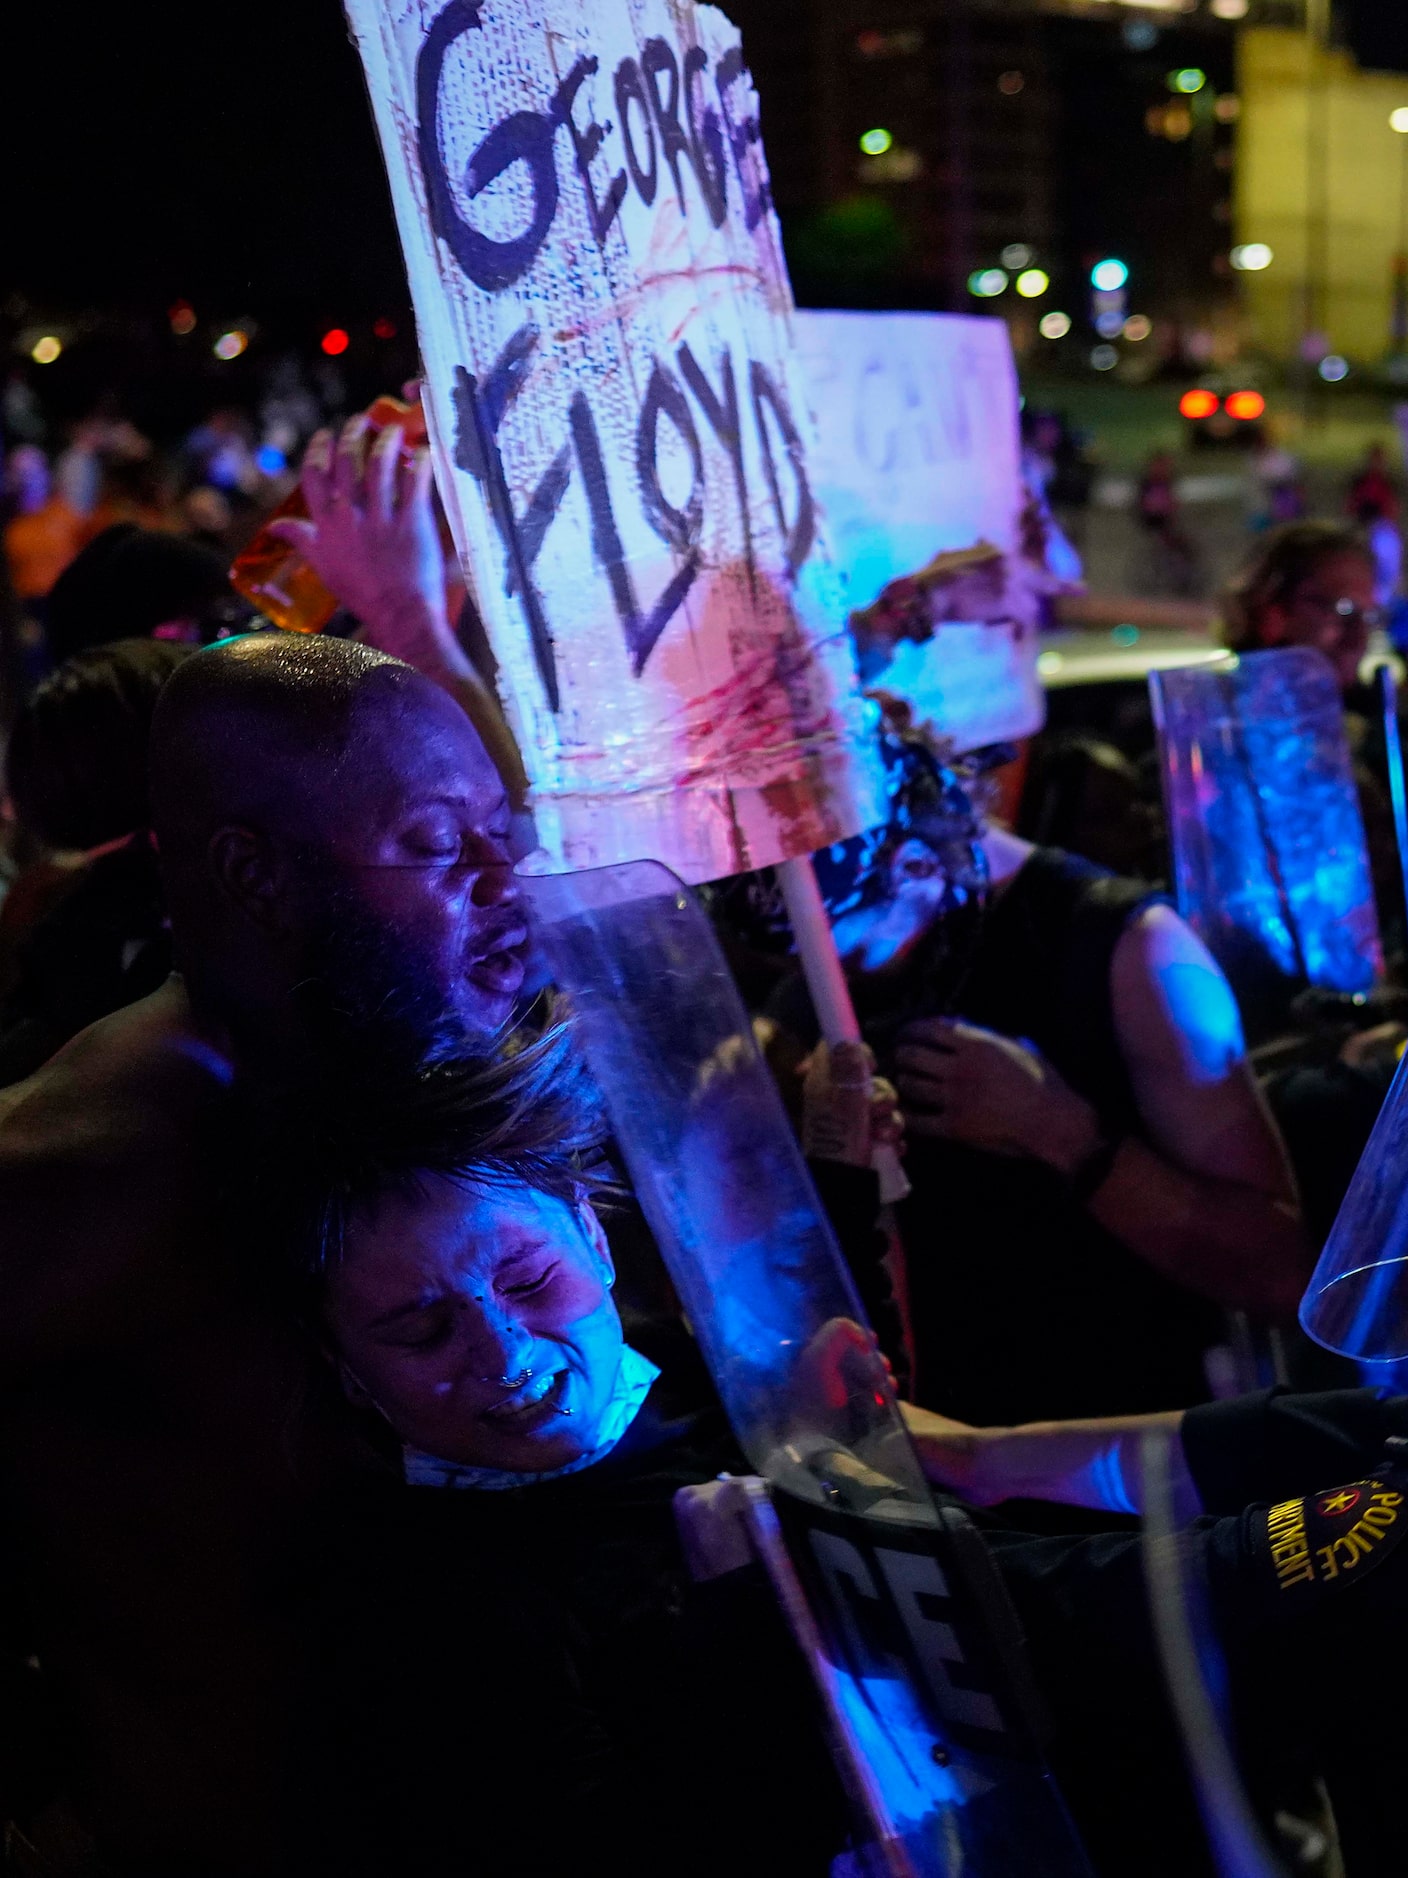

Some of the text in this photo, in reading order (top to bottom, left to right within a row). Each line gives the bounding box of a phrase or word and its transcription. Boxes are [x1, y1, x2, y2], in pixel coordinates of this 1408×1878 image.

[416, 0, 775, 291] GEORGE
[453, 322, 815, 712] FLOYD
[1316, 1491, 1405, 1582] POLICE
